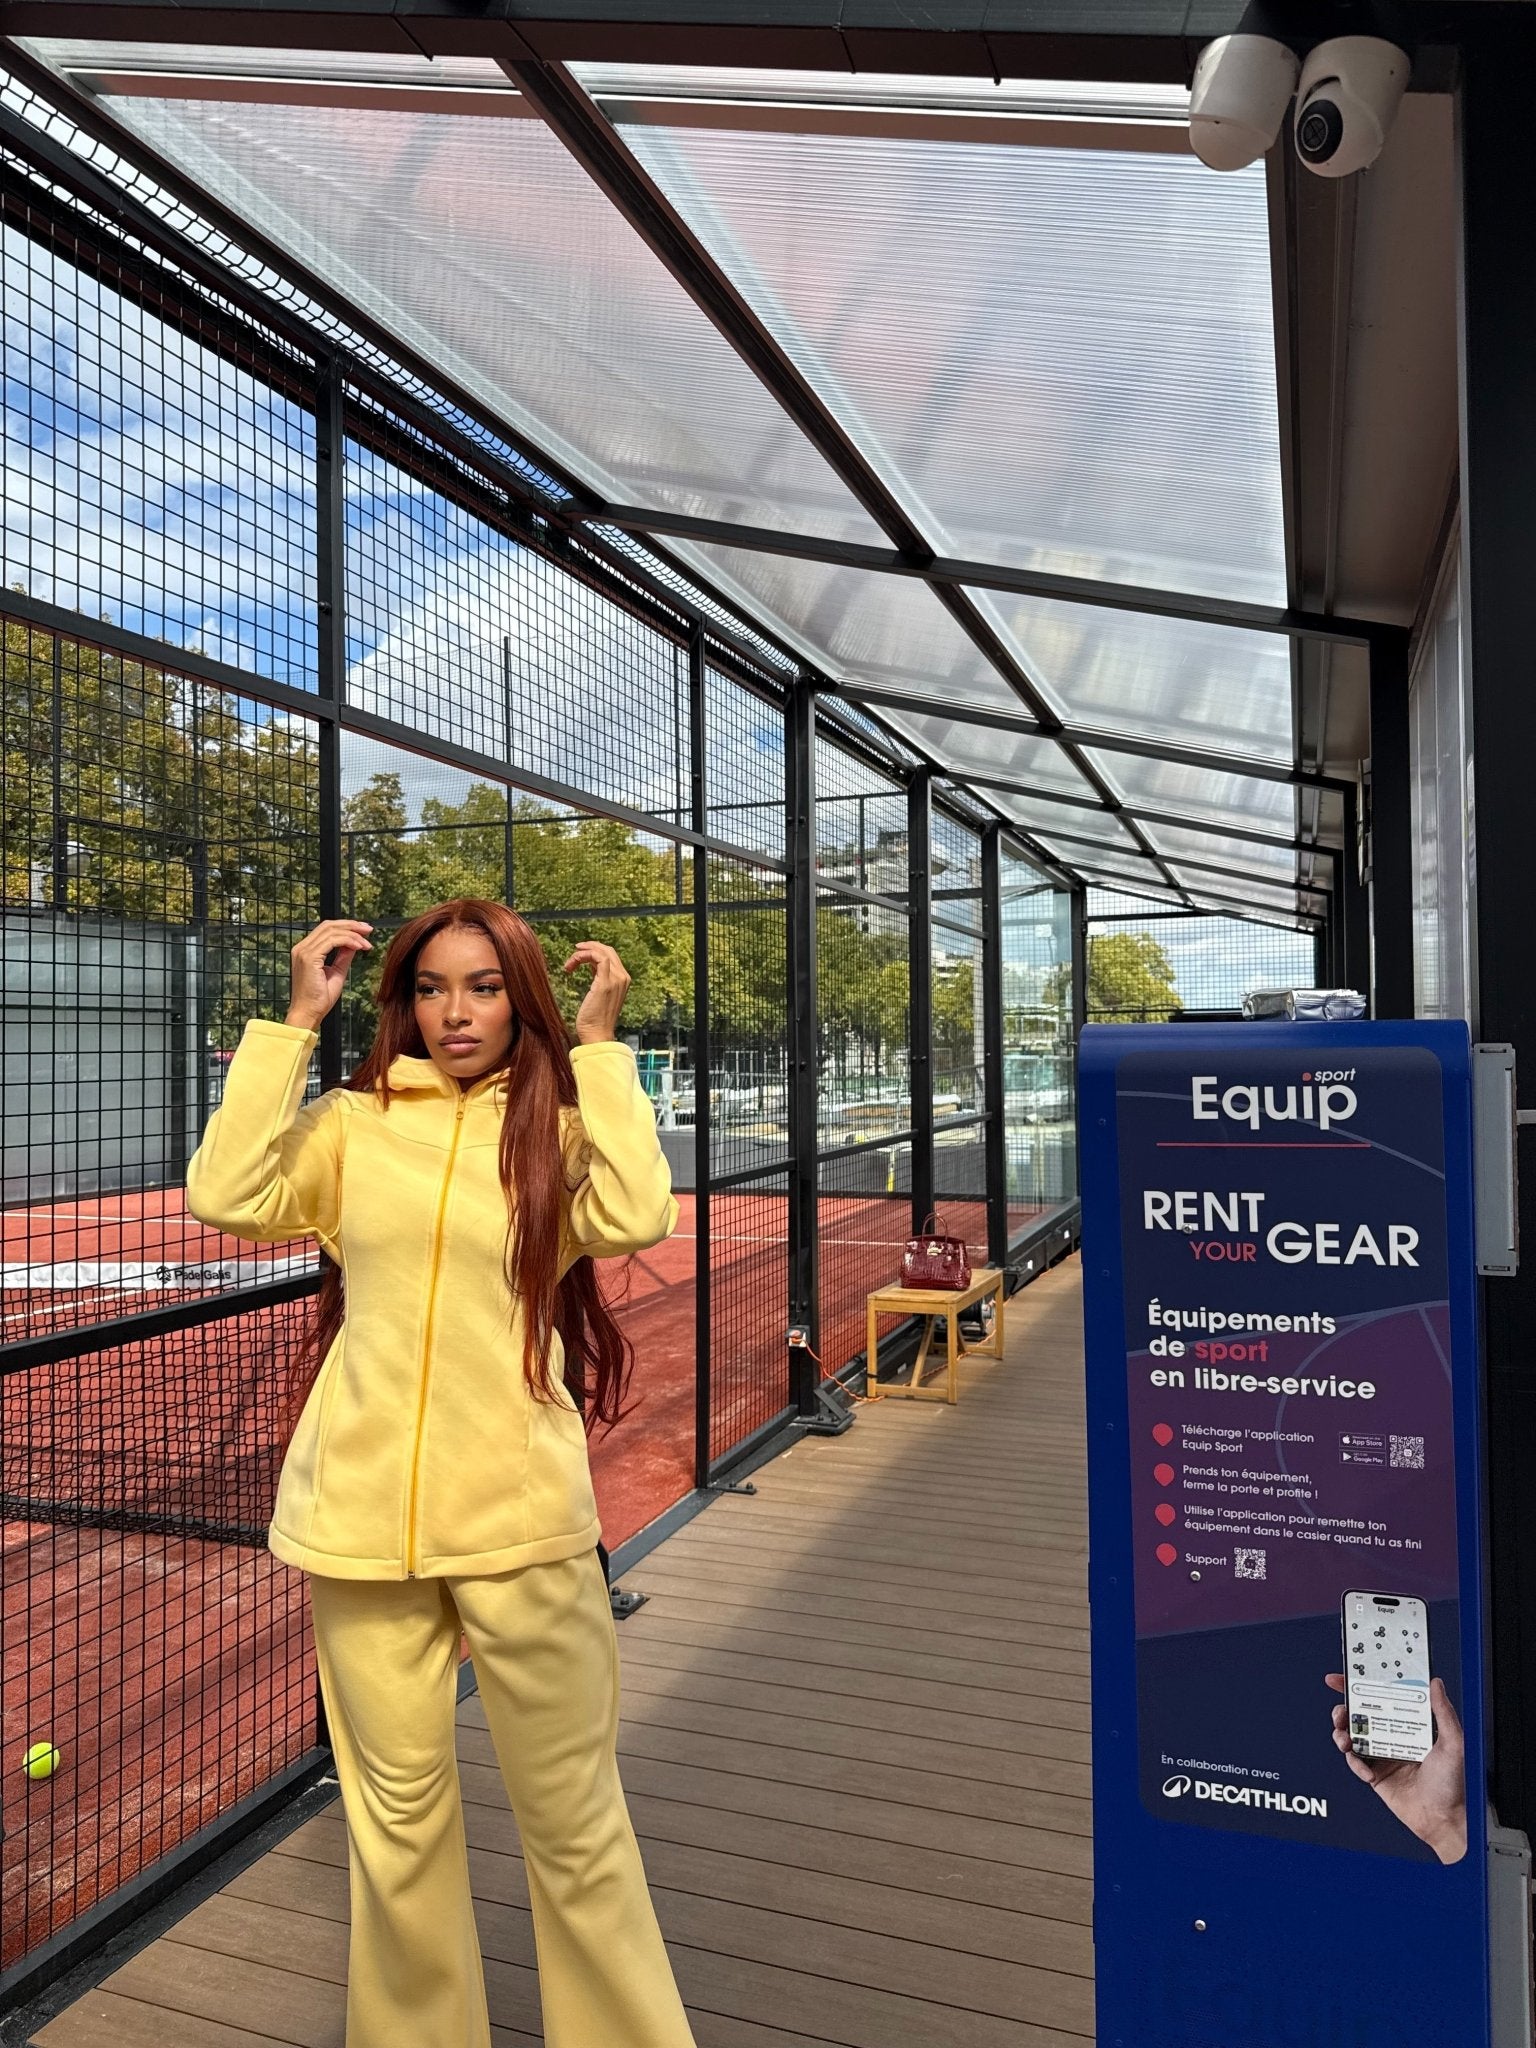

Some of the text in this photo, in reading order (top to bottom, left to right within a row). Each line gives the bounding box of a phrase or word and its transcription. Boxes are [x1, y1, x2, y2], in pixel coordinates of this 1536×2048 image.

[1314, 1068, 1356, 1083] sport
[1192, 1073, 1358, 1130] Equip
[1144, 1190, 1265, 1233] RENT
[1189, 1240, 1257, 1262] YOUR
[1266, 1221, 1420, 1267] GEAR
[1148, 1297, 1336, 1335] Équipements
[1149, 1335, 1268, 1364] de sport
[1150, 1367, 1376, 1400] en libre-service
[1181, 1424, 1315, 1443] Télécharge l'application
[1182, 1439, 1243, 1453] Equip Sport
[1183, 1465, 1312, 1485] Prends ton équipement,
[1183, 1479, 1319, 1500] ferme la porte et profite !
[1184, 1504, 1387, 1531] Utilise l'application pour remettre ton
[1184, 1518, 1422, 1550] équipement dans le casier quand tu as fini
[1185, 1553, 1228, 1566] Support
[1161, 1754, 1281, 1780] En collaboration avec
[1195, 1780, 1328, 1818] DECATHLON
